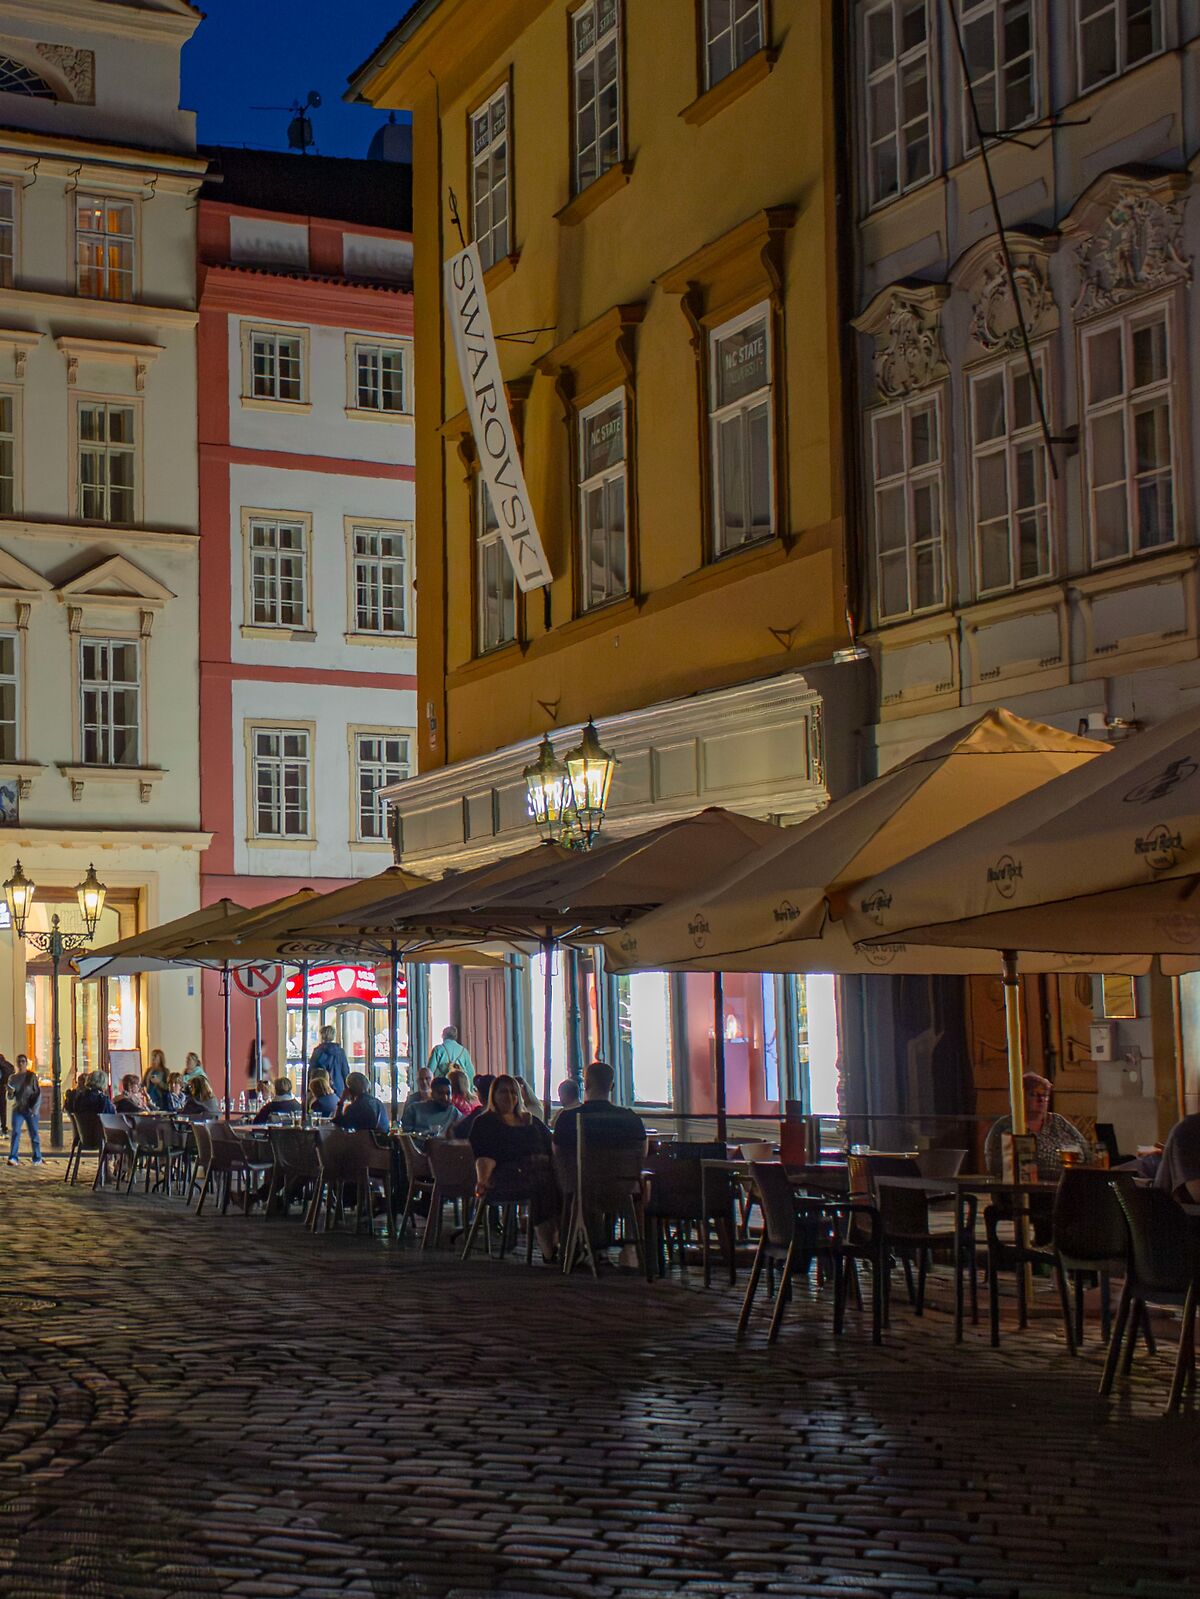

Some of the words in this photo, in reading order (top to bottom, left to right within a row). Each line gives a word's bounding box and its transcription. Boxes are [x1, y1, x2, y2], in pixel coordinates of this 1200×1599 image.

[738, 336, 765, 364] STATE
[452, 253, 544, 583] SWAROVSKI
[601, 416, 621, 441] STATE
